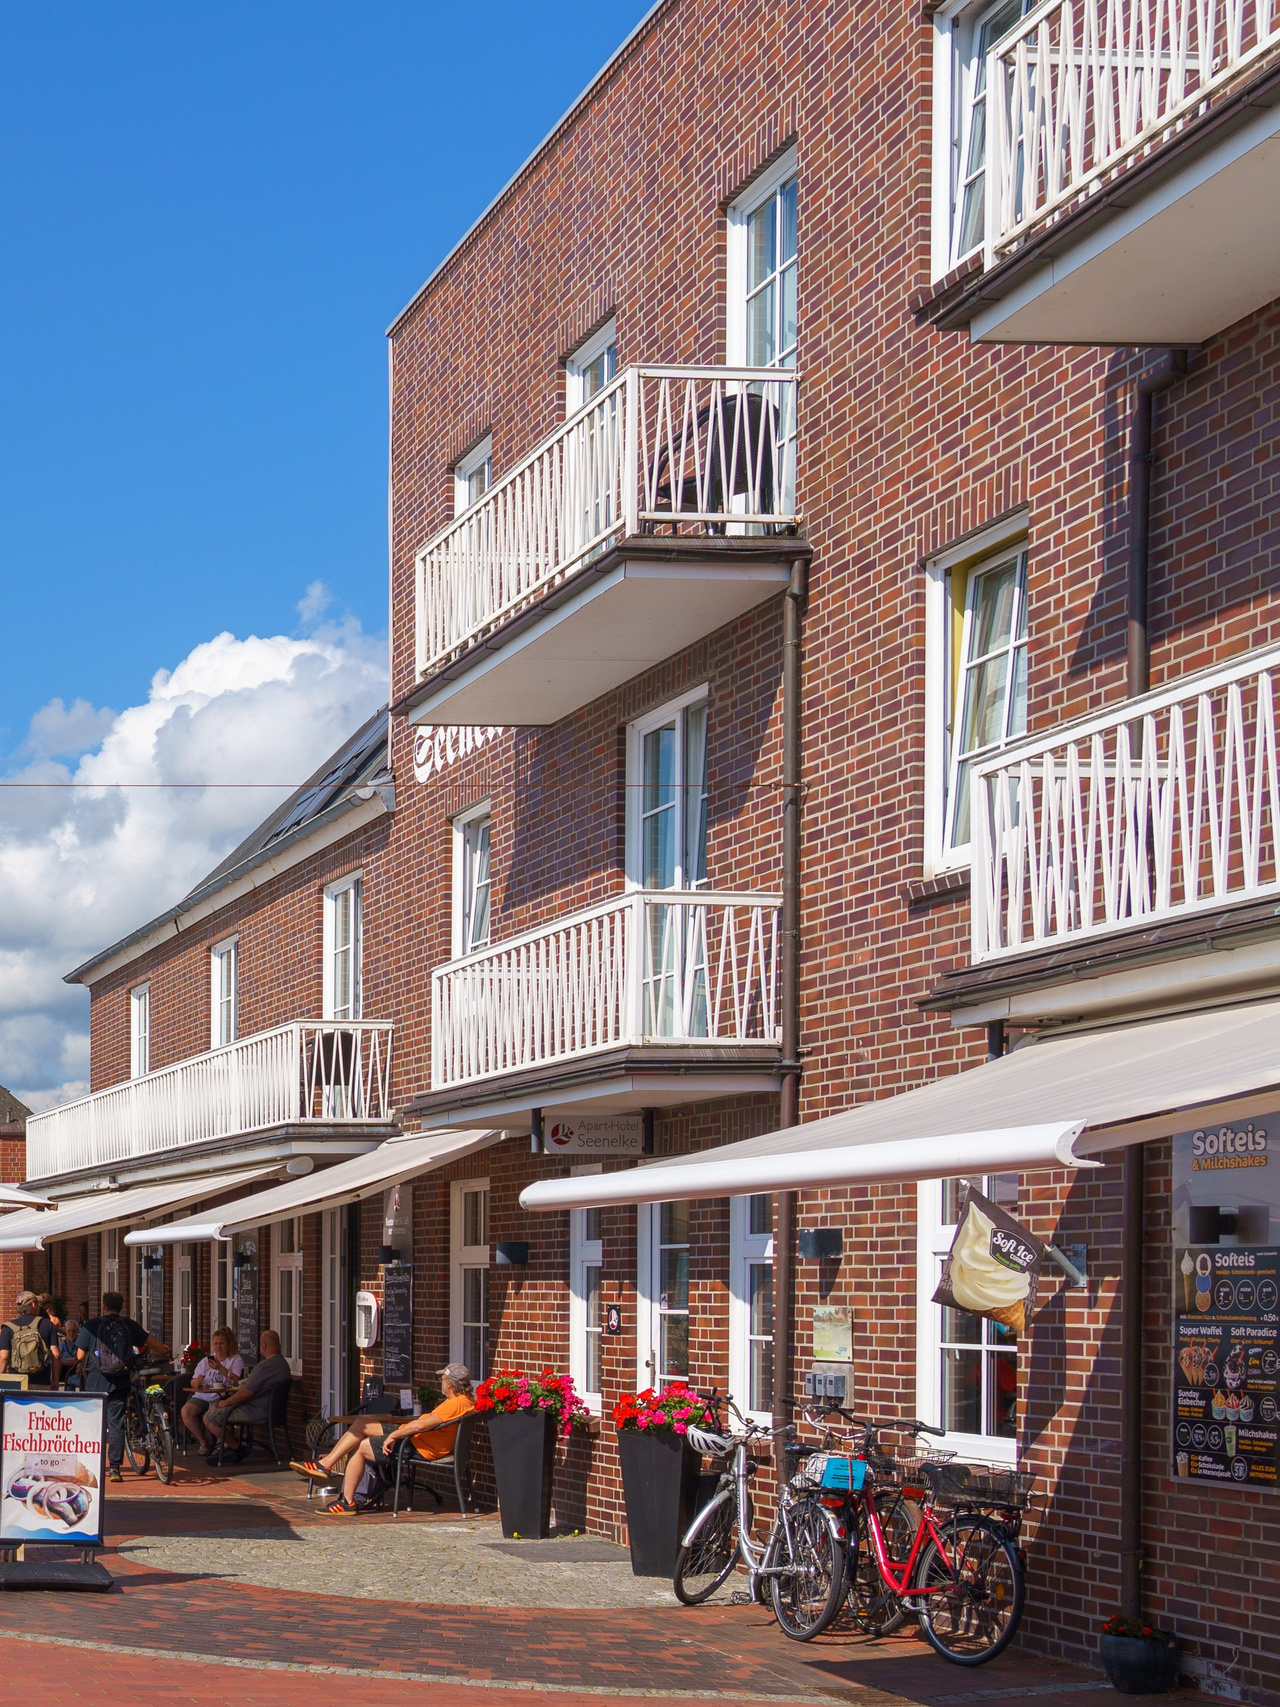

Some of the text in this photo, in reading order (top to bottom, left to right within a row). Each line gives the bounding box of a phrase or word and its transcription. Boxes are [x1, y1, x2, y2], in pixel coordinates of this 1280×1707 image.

[578, 1120, 639, 1133] Apart-Hotel
[578, 1133, 638, 1148] Seenelke
[1192, 1124, 1267, 1156] Softeis
[1192, 1154, 1267, 1171] & Milchshakes
[993, 1232, 1034, 1263] Soft Ice
[1214, 1251, 1255, 1267] Softeis
[1179, 1326, 1223, 1336] Super Waffel
[1231, 1327, 1277, 1337] Soft Paradice
[1178, 1390, 1199, 1400] Sunday
[1178, 1398, 1206, 1407] Eisbecher
[28, 1410, 72, 1432] Frische
[1238, 1429, 1277, 1440] Milchshakes
[3, 1432, 100, 1454] Fischbrötchen
